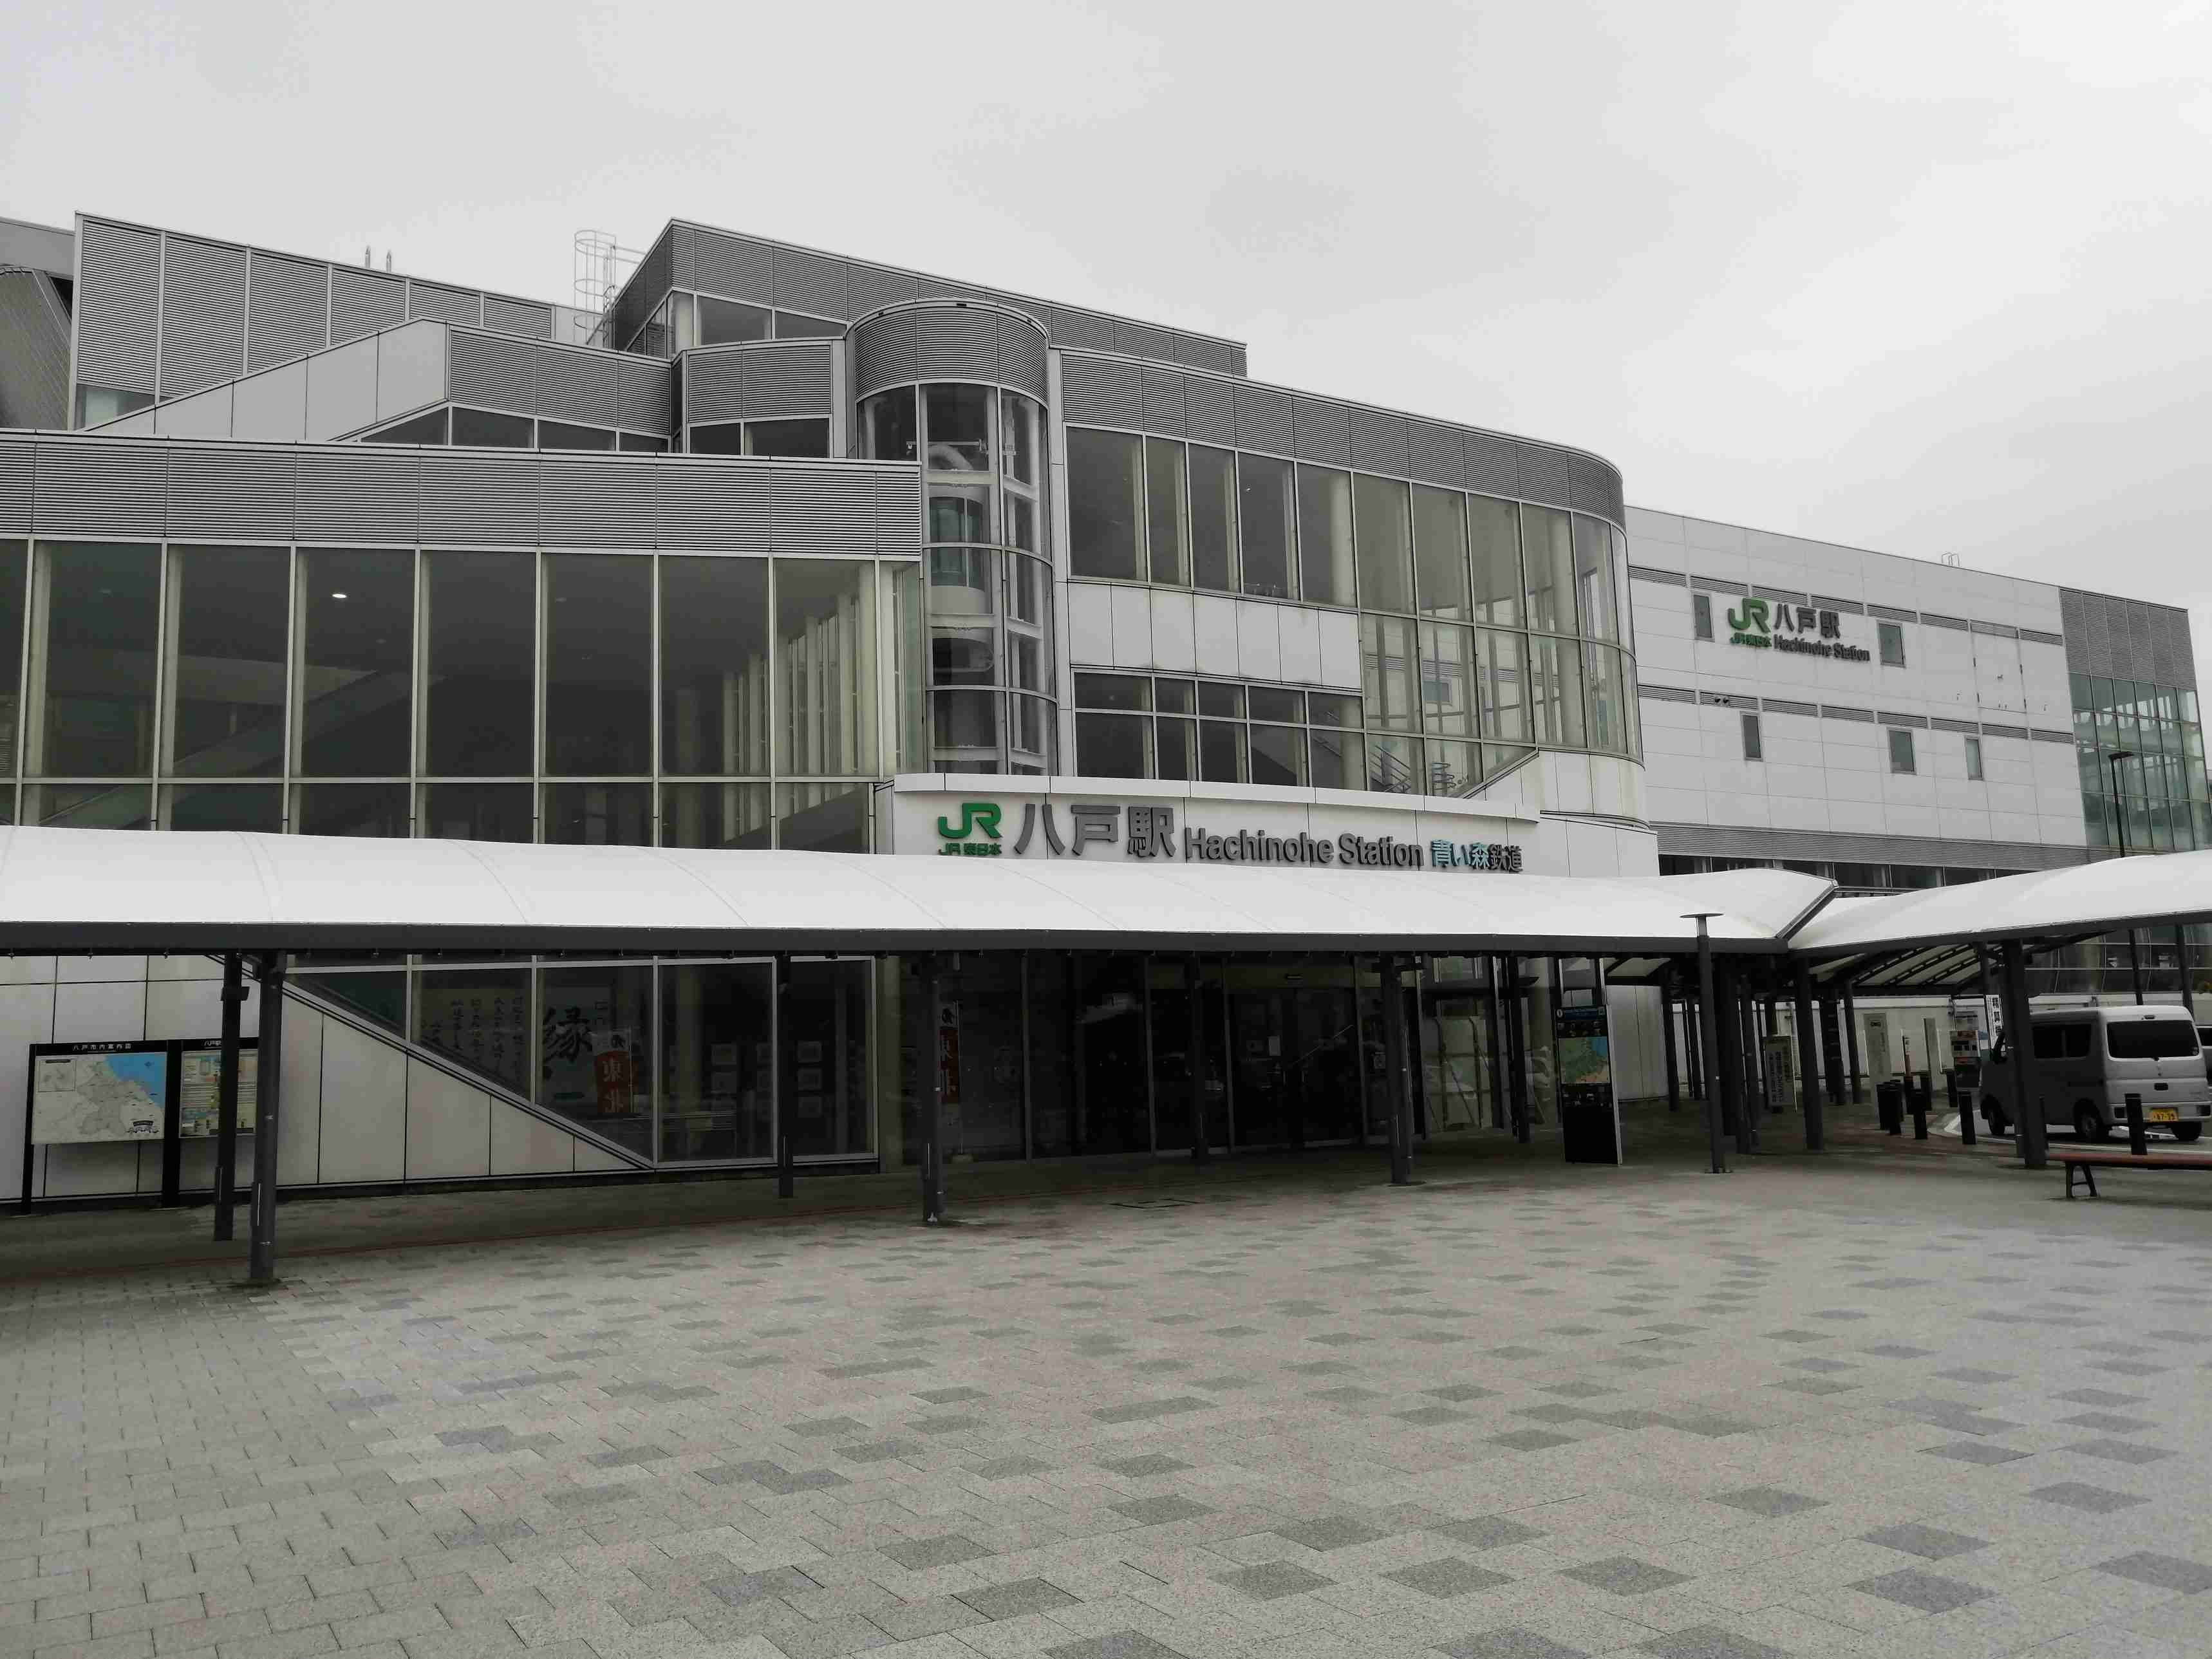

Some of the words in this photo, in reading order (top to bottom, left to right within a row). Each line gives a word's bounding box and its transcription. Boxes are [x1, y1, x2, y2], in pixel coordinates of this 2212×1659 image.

[1728, 597, 1770, 633] JR
[1774, 603, 1841, 639] 八戸駅
[1774, 634, 1833, 657] Hachinohe
[1833, 642, 1870, 661] Station
[937, 803, 1002, 839] JR
[1014, 803, 1177, 858] 八戸駅
[1185, 827, 1335, 863] Hachinohe
[1339, 833, 1425, 867] Station
[1430, 839, 1523, 873] 青い森鉄道
